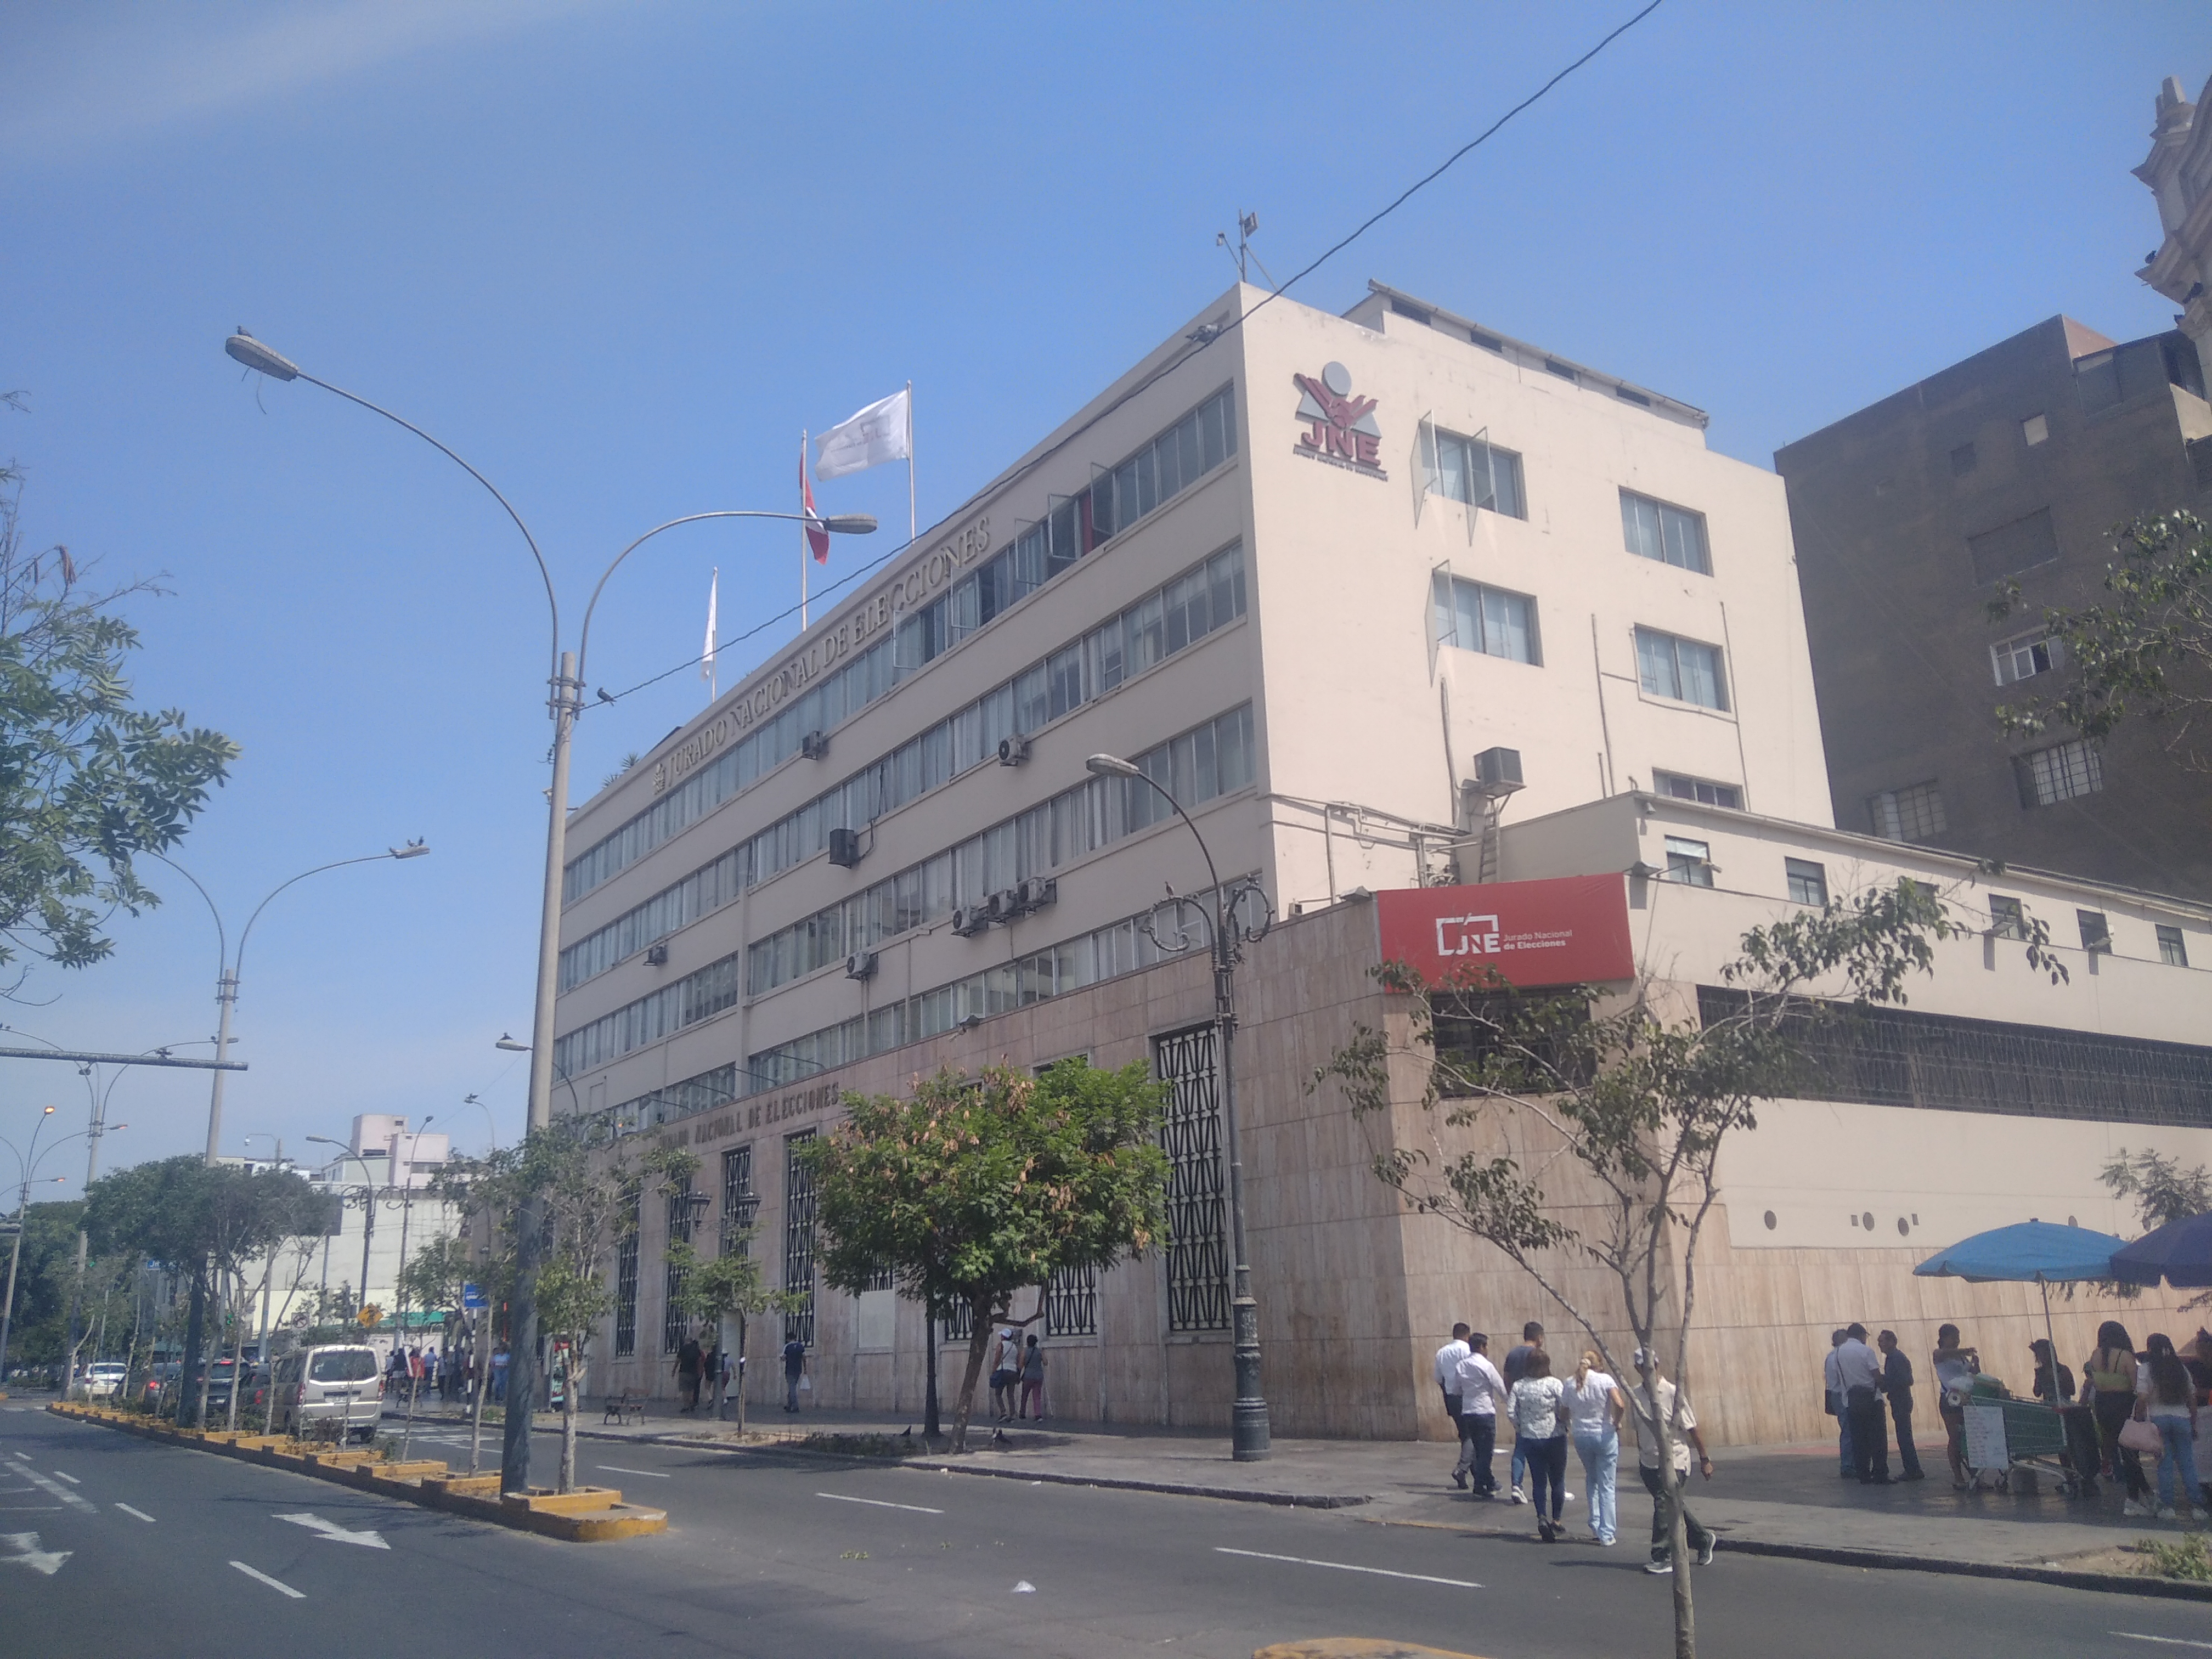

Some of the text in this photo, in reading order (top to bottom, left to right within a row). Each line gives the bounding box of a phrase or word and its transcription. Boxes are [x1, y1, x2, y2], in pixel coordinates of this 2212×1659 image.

[1301, 419, 1381, 467] JNE
[668, 517, 990, 787] JURADO NACIONAL DE ELECCIONES
[1503, 929, 1573, 942] Jurado Nacional
[1503, 939, 1566, 951] de Elecciones
[748, 1104, 761, 1130] DE
[765, 1081, 839, 1125] ELECCIONES
